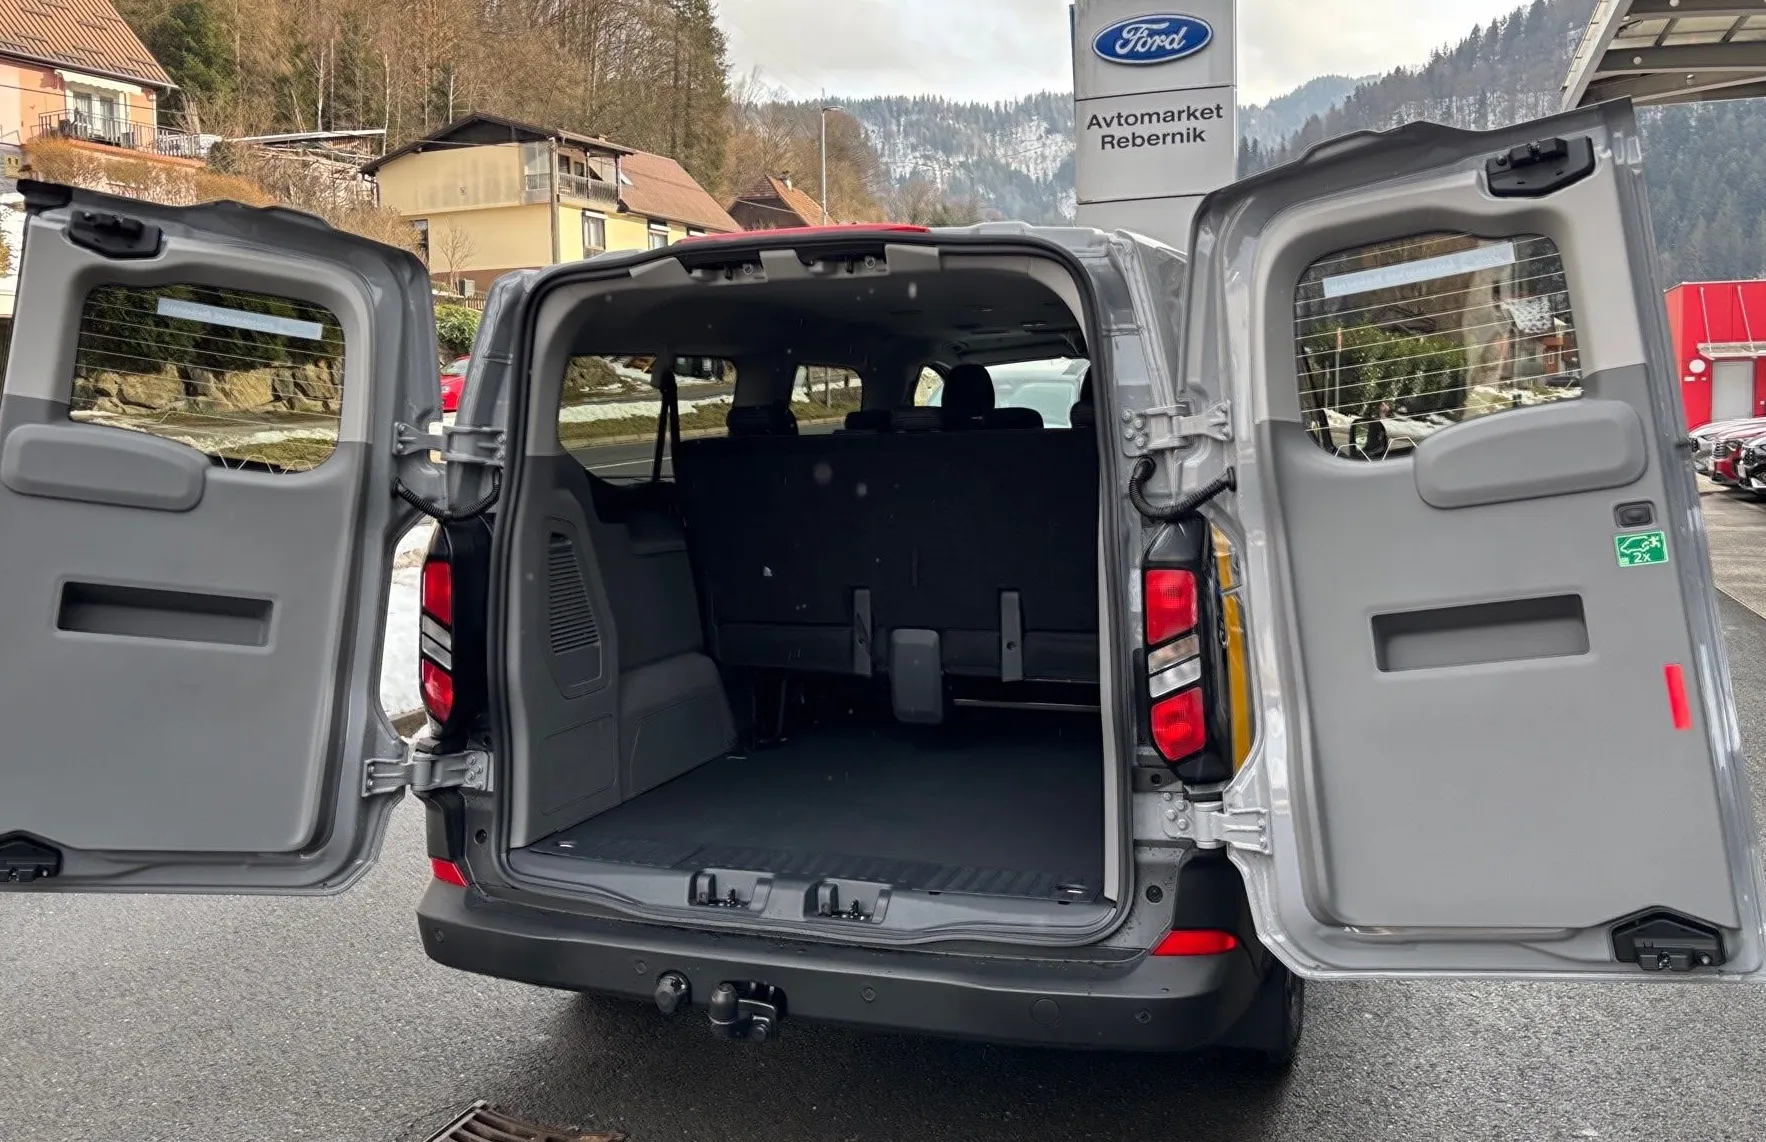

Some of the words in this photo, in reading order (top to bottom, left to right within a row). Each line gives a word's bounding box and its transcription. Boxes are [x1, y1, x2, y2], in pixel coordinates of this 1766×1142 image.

[1115, 21, 1188, 55] Ford
[1086, 103, 1223, 130] Avtomarket
[1101, 127, 1206, 150] Rebernik
[1633, 552, 1652, 563] 2x
